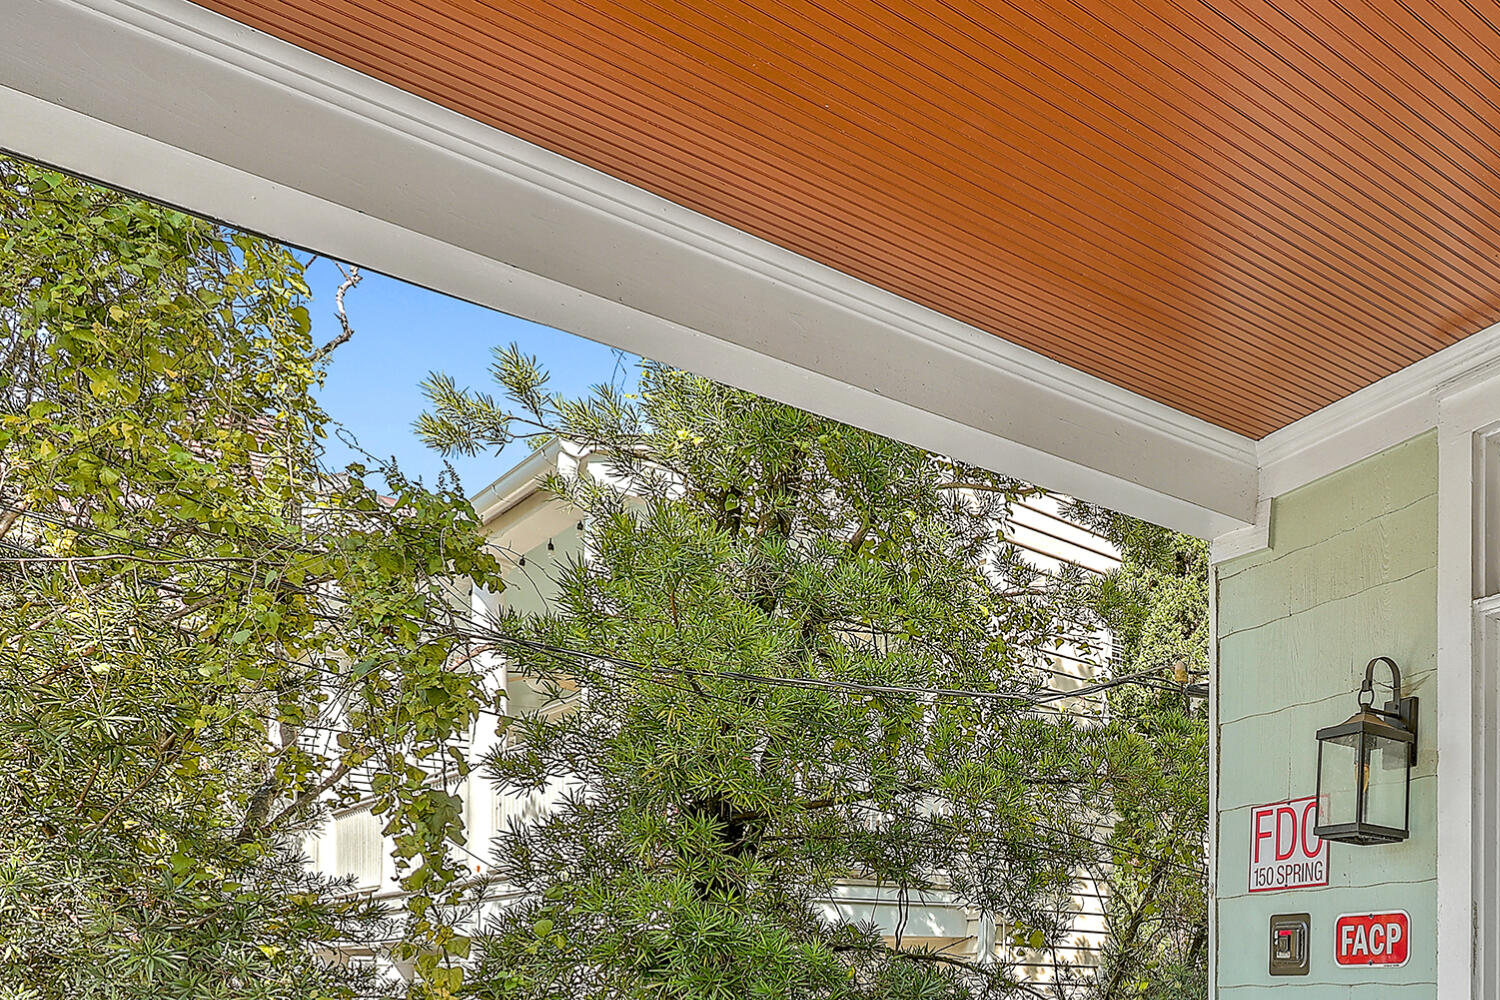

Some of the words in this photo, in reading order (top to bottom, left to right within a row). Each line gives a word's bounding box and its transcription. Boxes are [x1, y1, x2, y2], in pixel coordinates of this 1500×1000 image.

[1254, 867, 1274, 886] 150
[1277, 861, 1323, 884] SPRING
[1341, 923, 1402, 956] FACP
